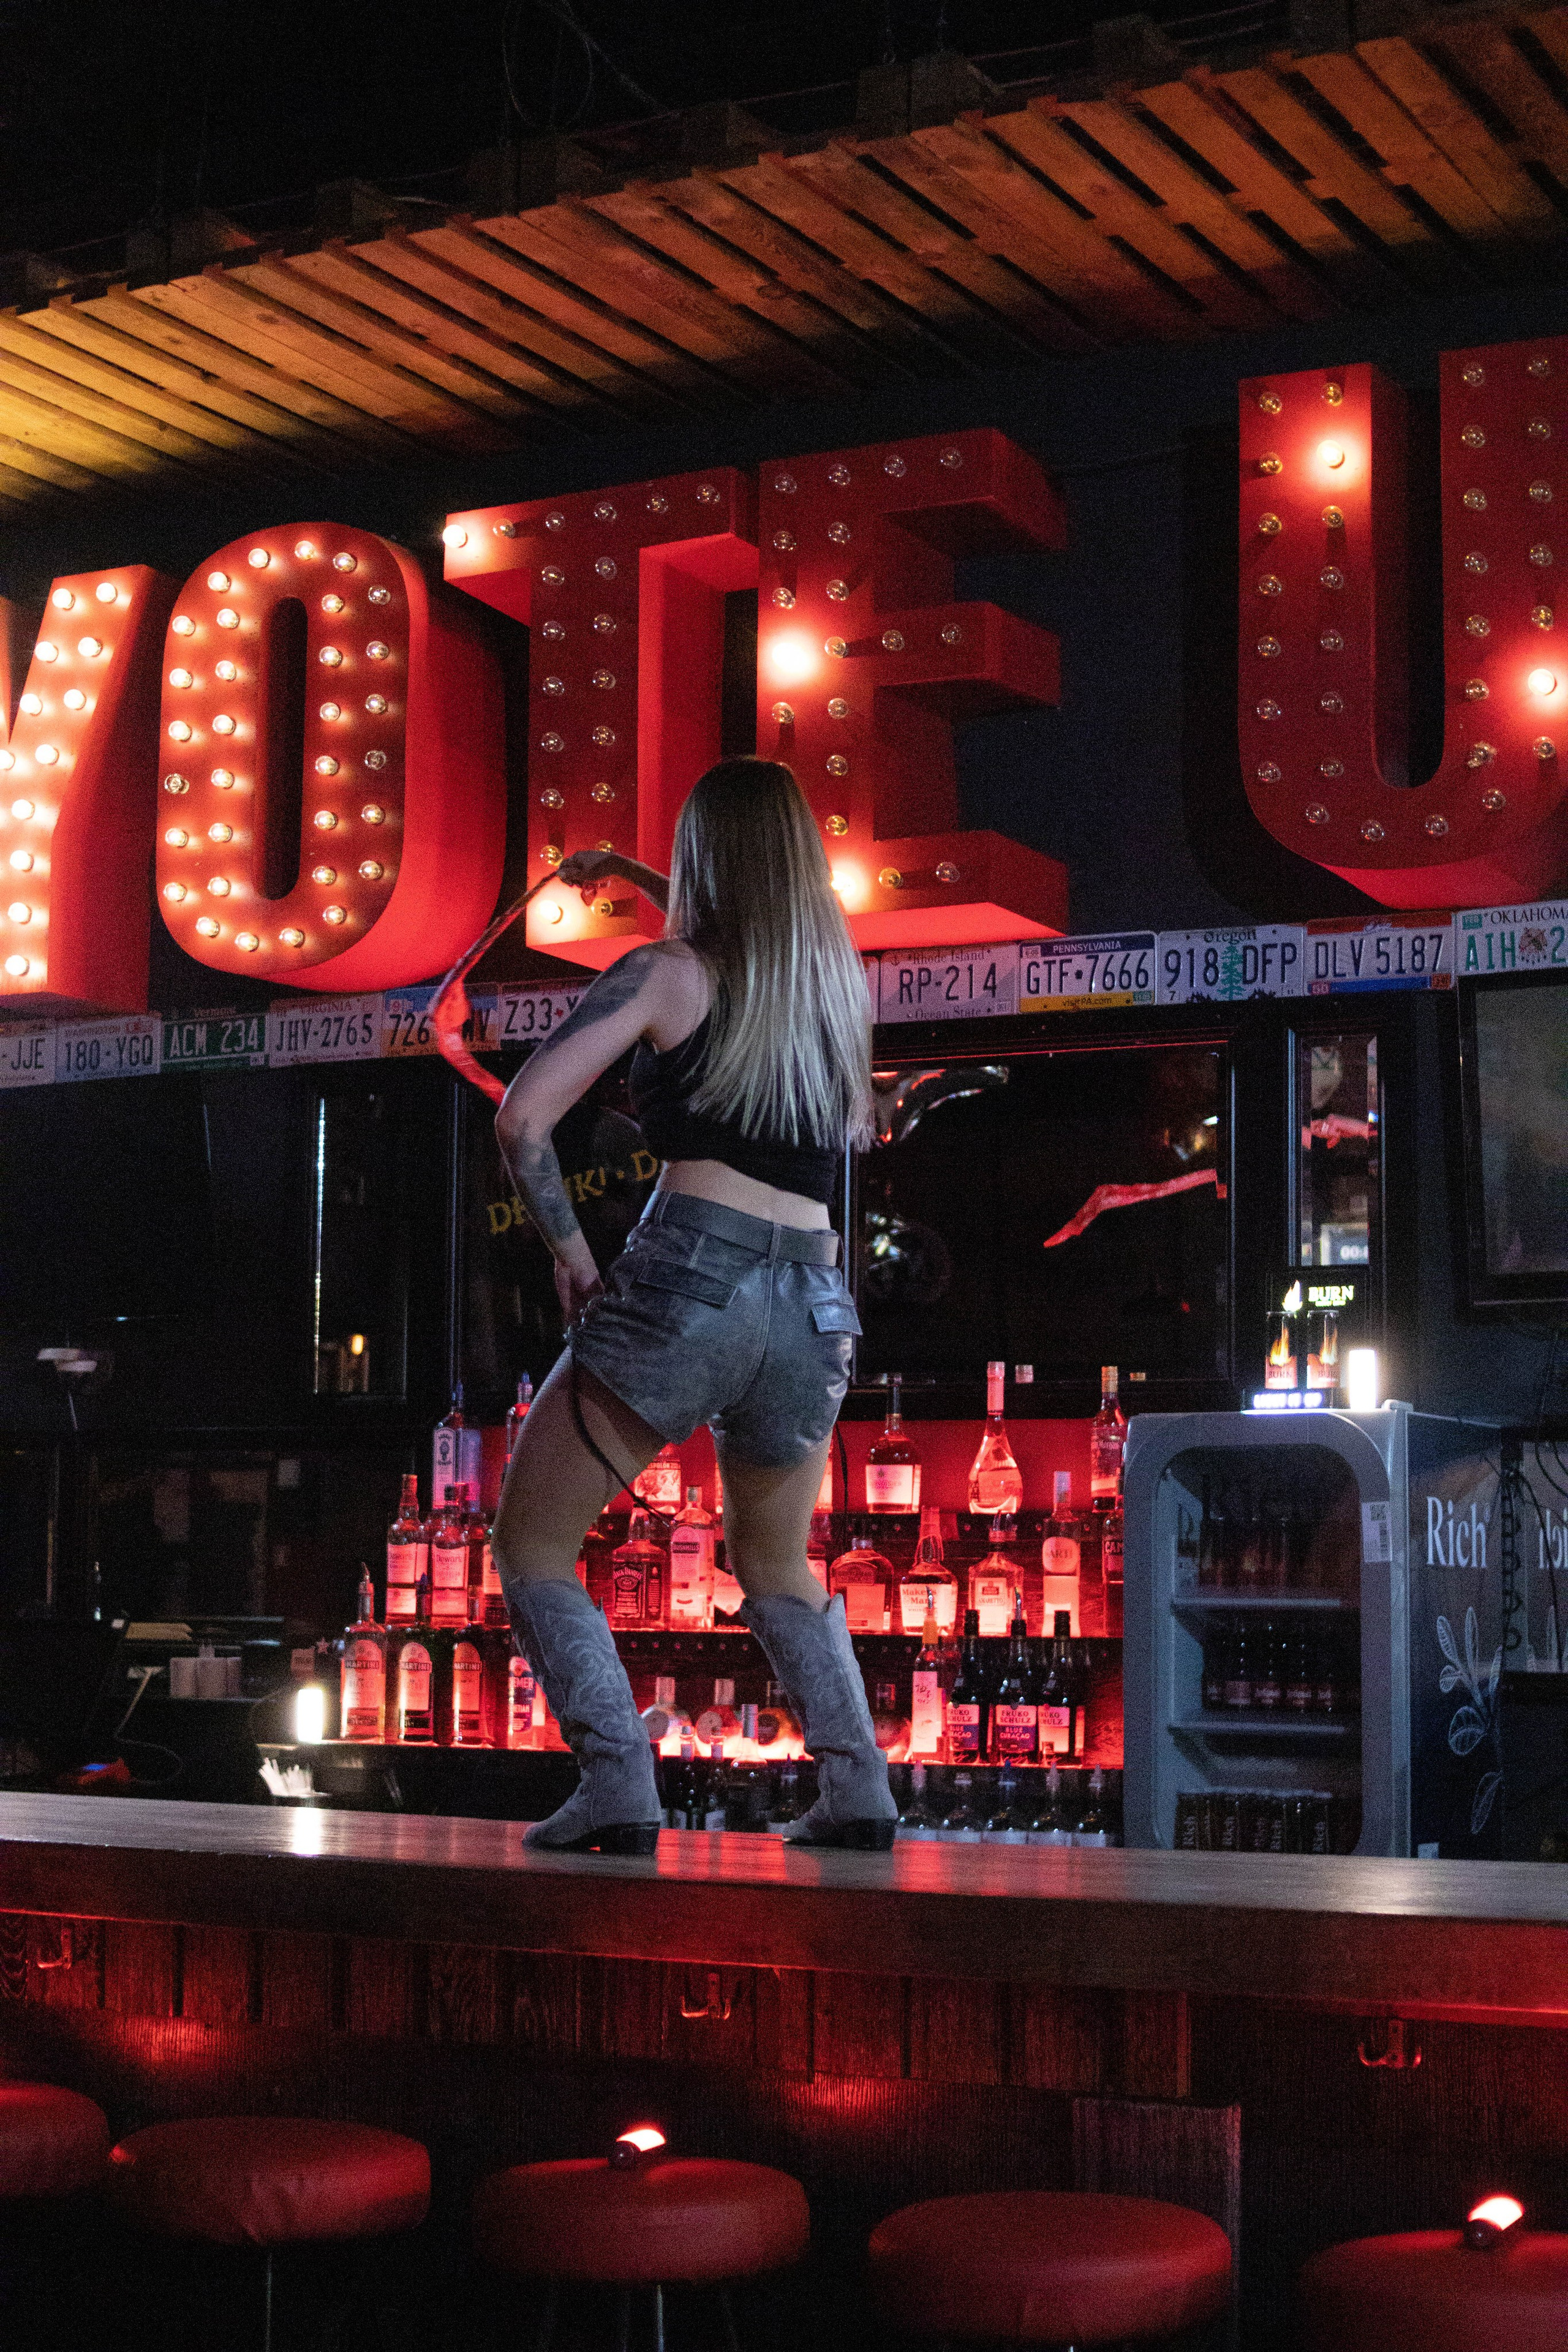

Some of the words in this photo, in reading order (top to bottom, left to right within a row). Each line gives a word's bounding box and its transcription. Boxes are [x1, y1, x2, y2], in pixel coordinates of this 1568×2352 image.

[1491, 907, 1568, 924] OKLAHOM
[1204, 930, 1256, 944] Oregon
[913, 954, 945, 965] Rhode
[951, 947, 985, 962] Island
[1053, 941, 1121, 954] PENNSYLVANIA
[1315, 938, 1363, 979] DLV
[1376, 934, 1442, 974] 5187
[1165, 948, 1219, 987] 918
[1242, 942, 1297, 985] DFP
[915, 1008, 950, 1020] Ocean
[953, 1005, 981, 1018] State
[169, 1022, 208, 1058] ACM
[220, 1018, 260, 1054] 234
[1308, 1284, 1355, 1302] BURN
[1426, 1496, 1488, 1569] Rich
